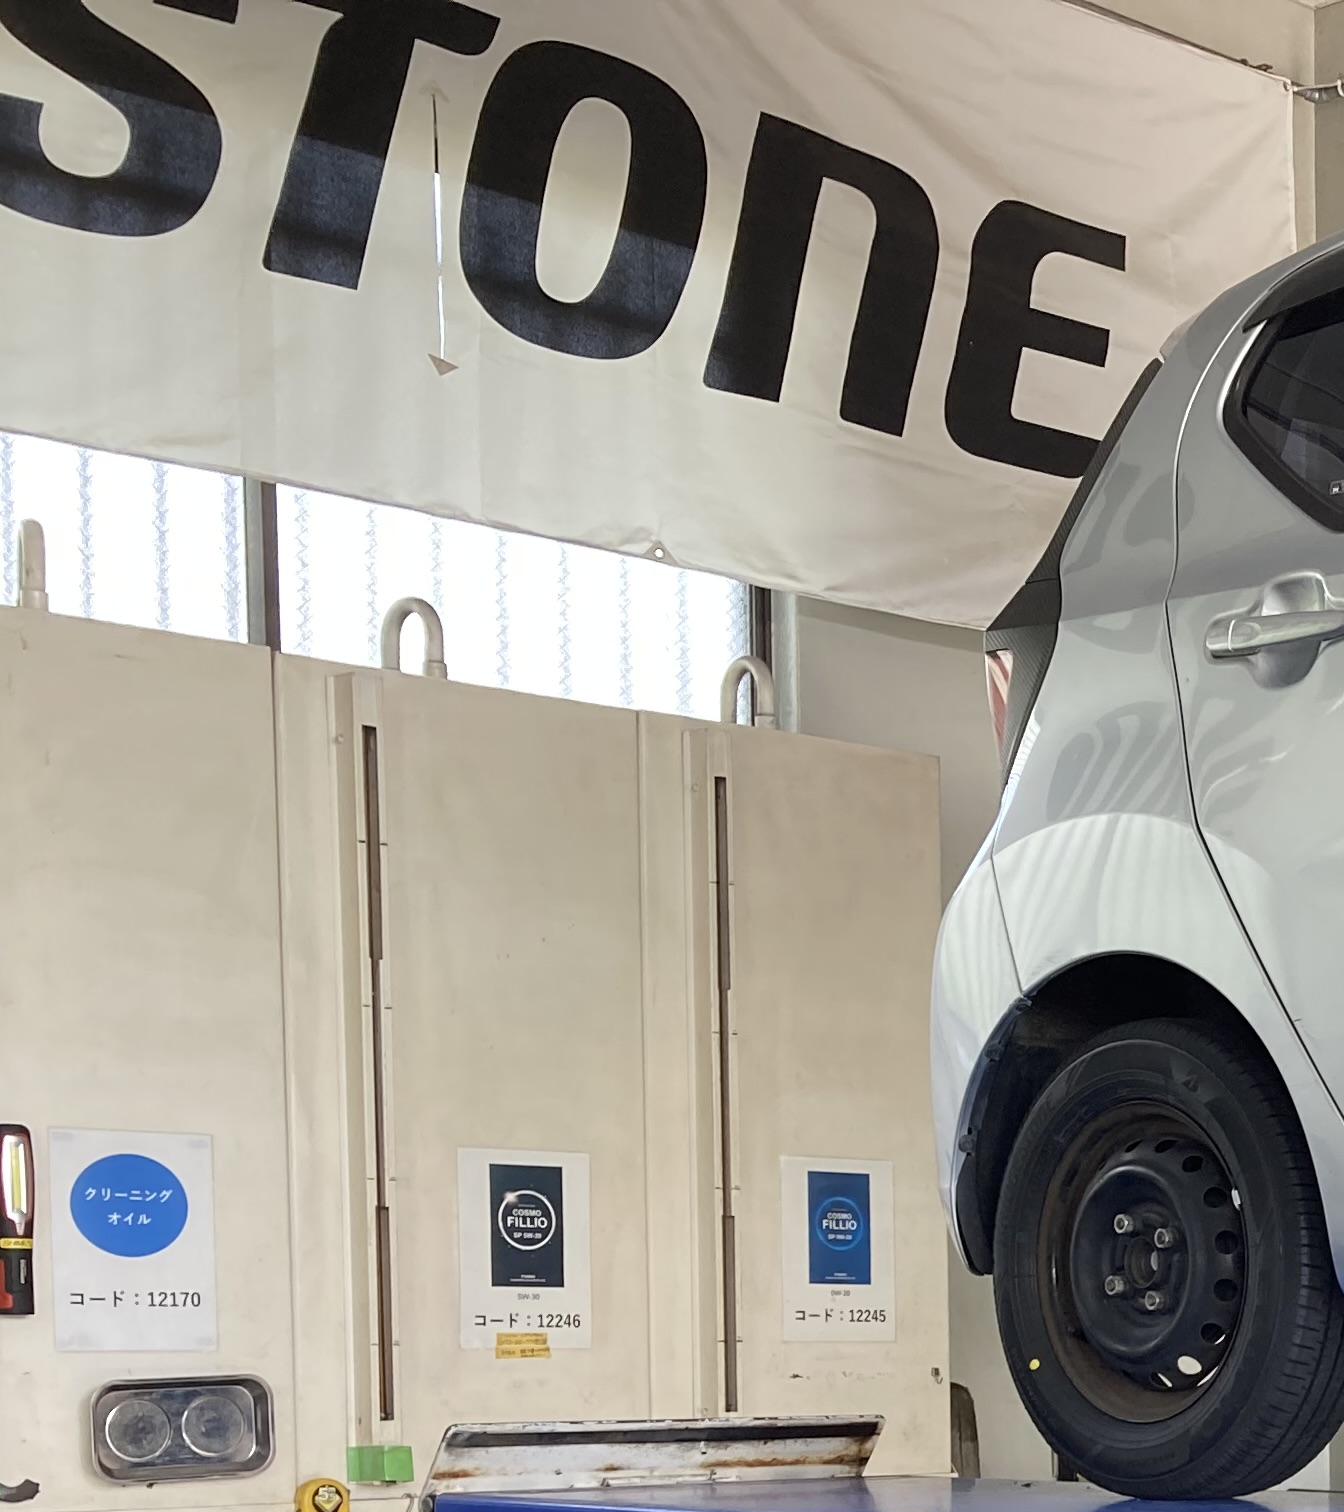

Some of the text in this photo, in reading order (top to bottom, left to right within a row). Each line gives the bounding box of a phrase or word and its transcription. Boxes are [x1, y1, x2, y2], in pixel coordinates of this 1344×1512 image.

[85, 1187, 173, 1203] クリーニング
[107, 1212, 152, 1226] オイル
[512, 1208, 542, 1217] COSMO
[506, 1216, 548, 1229] FILLIO
[822, 1219, 857, 1230] FILLIO
